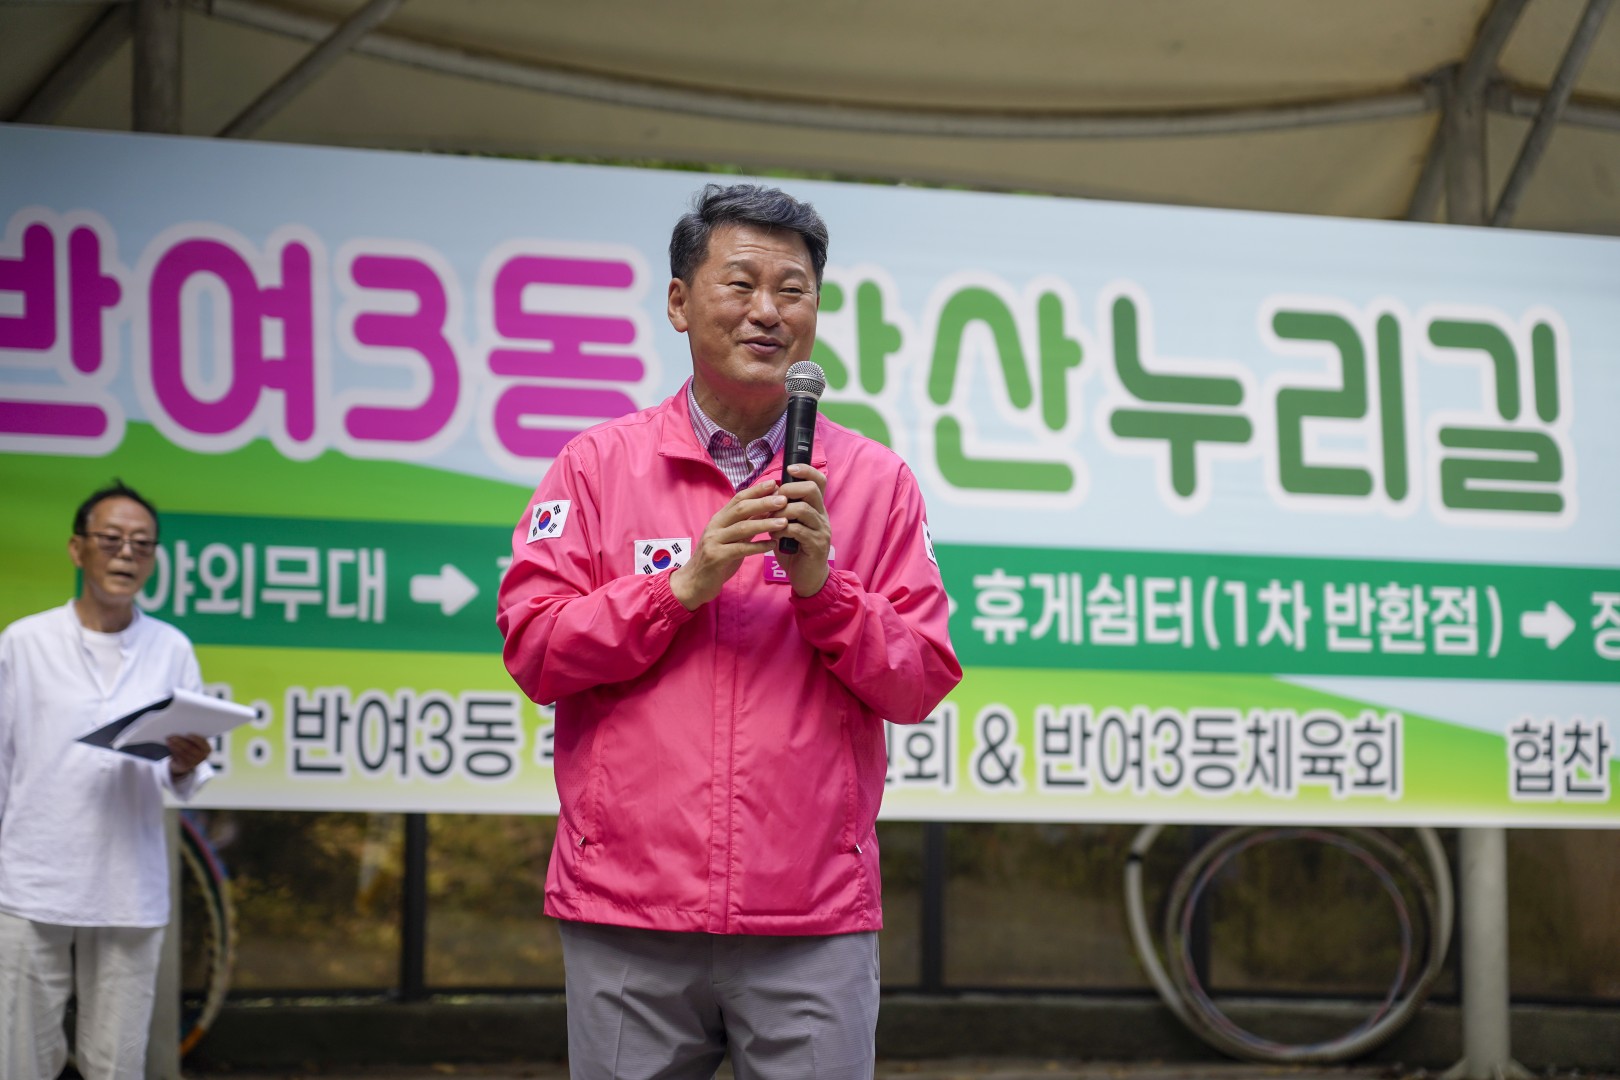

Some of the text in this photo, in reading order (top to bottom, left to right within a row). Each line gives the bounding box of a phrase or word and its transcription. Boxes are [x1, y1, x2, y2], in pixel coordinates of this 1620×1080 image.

[0, 220, 646, 462] 반여3동
[134, 540, 387, 624] 야외무대
[971, 568, 1311, 651] 휴게쉼터(1차
[1323, 581, 1502, 658] 반환점)
[293, 694, 515, 777] 반여3동
[976, 711, 1017, 786] &
[1042, 711, 1398, 795] 반여3동체육회
[1511, 718, 1609, 796] 협찬
